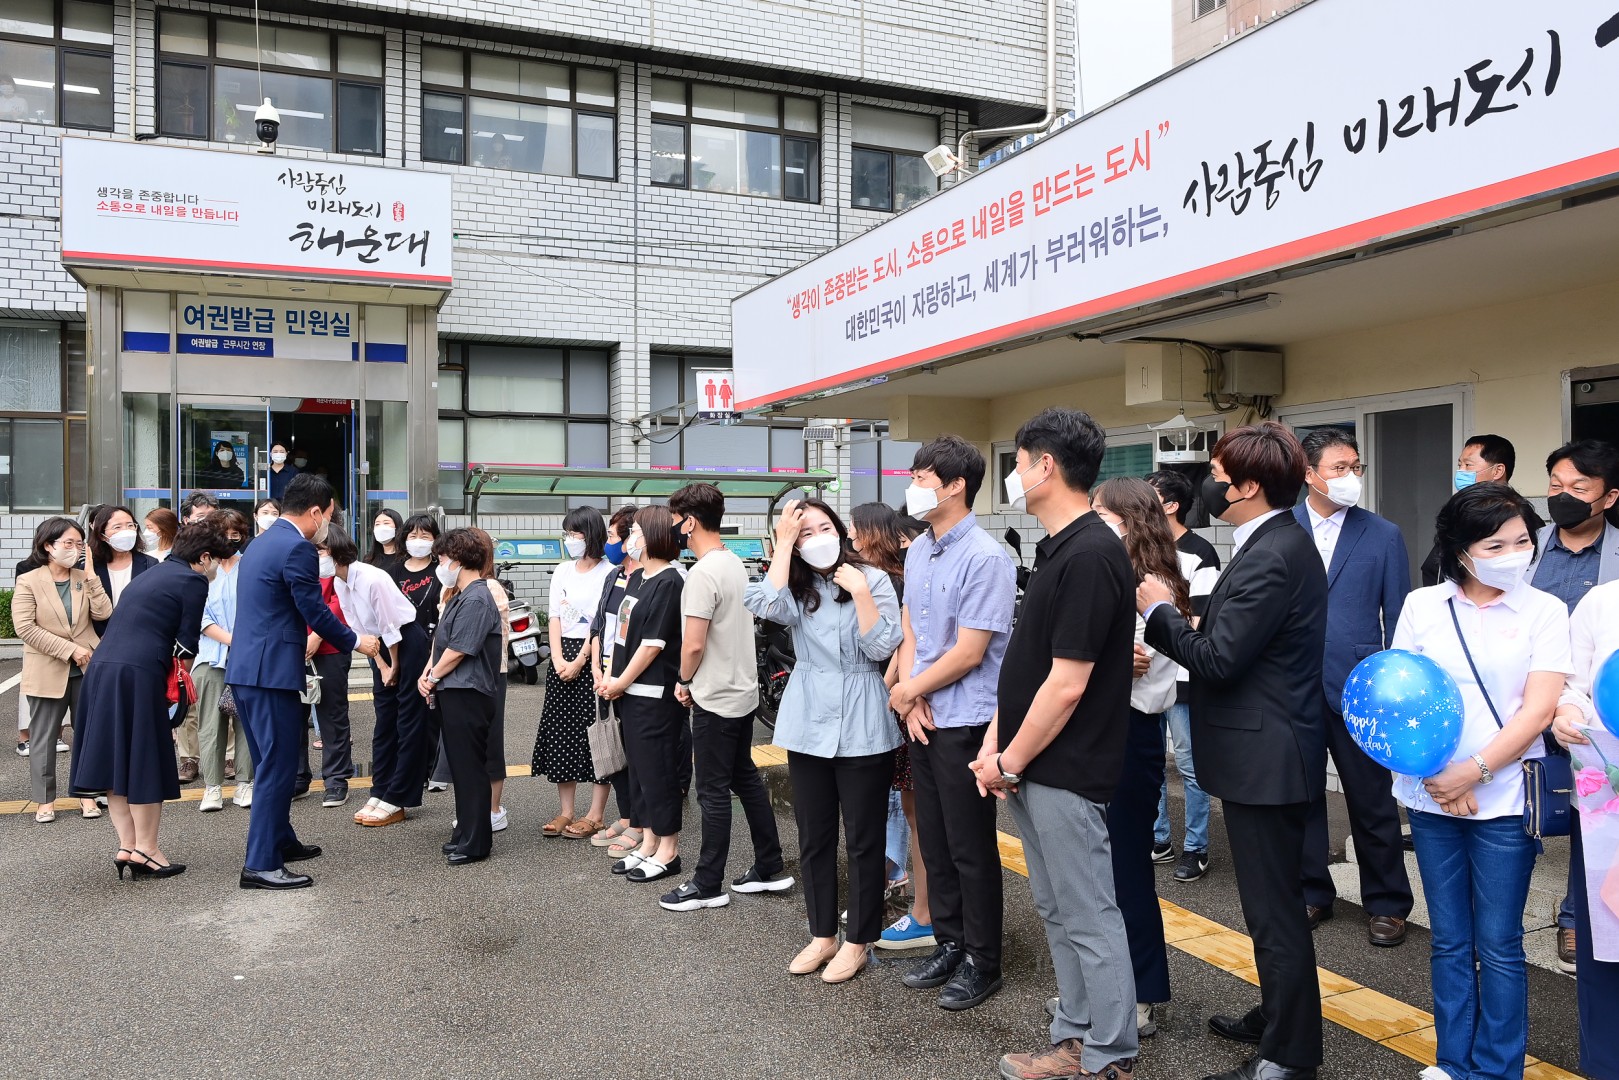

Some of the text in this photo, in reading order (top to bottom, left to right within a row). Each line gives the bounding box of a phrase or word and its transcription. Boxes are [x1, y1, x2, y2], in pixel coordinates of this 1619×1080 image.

[1183, 30, 1562, 217] 사람중심 미래도시
[96, 186, 200, 206] 생각을 존중합니다
[277, 167, 347, 196] 사람중심
[96, 199, 240, 222] 소통으로 내일을 만듭니다
[307, 199, 381, 219] 미래도시
[288, 221, 430, 268] 해운대
[823, 265, 869, 306] 존중받는
[872, 248, 904, 284] 도시,
[906, 218, 967, 269] 소통으로
[971, 189, 1026, 239] 내일을
[1032, 163, 1096, 218] 만드는
[844, 203, 1169, 342] 대한민국이 자랑하고, 세계가 부러워하는,
[183, 304, 351, 338] 여권발급 민원실
[191, 338, 266, 351] 여권발급 근무시간 연장
[1342, 698, 1379, 736] Happy
